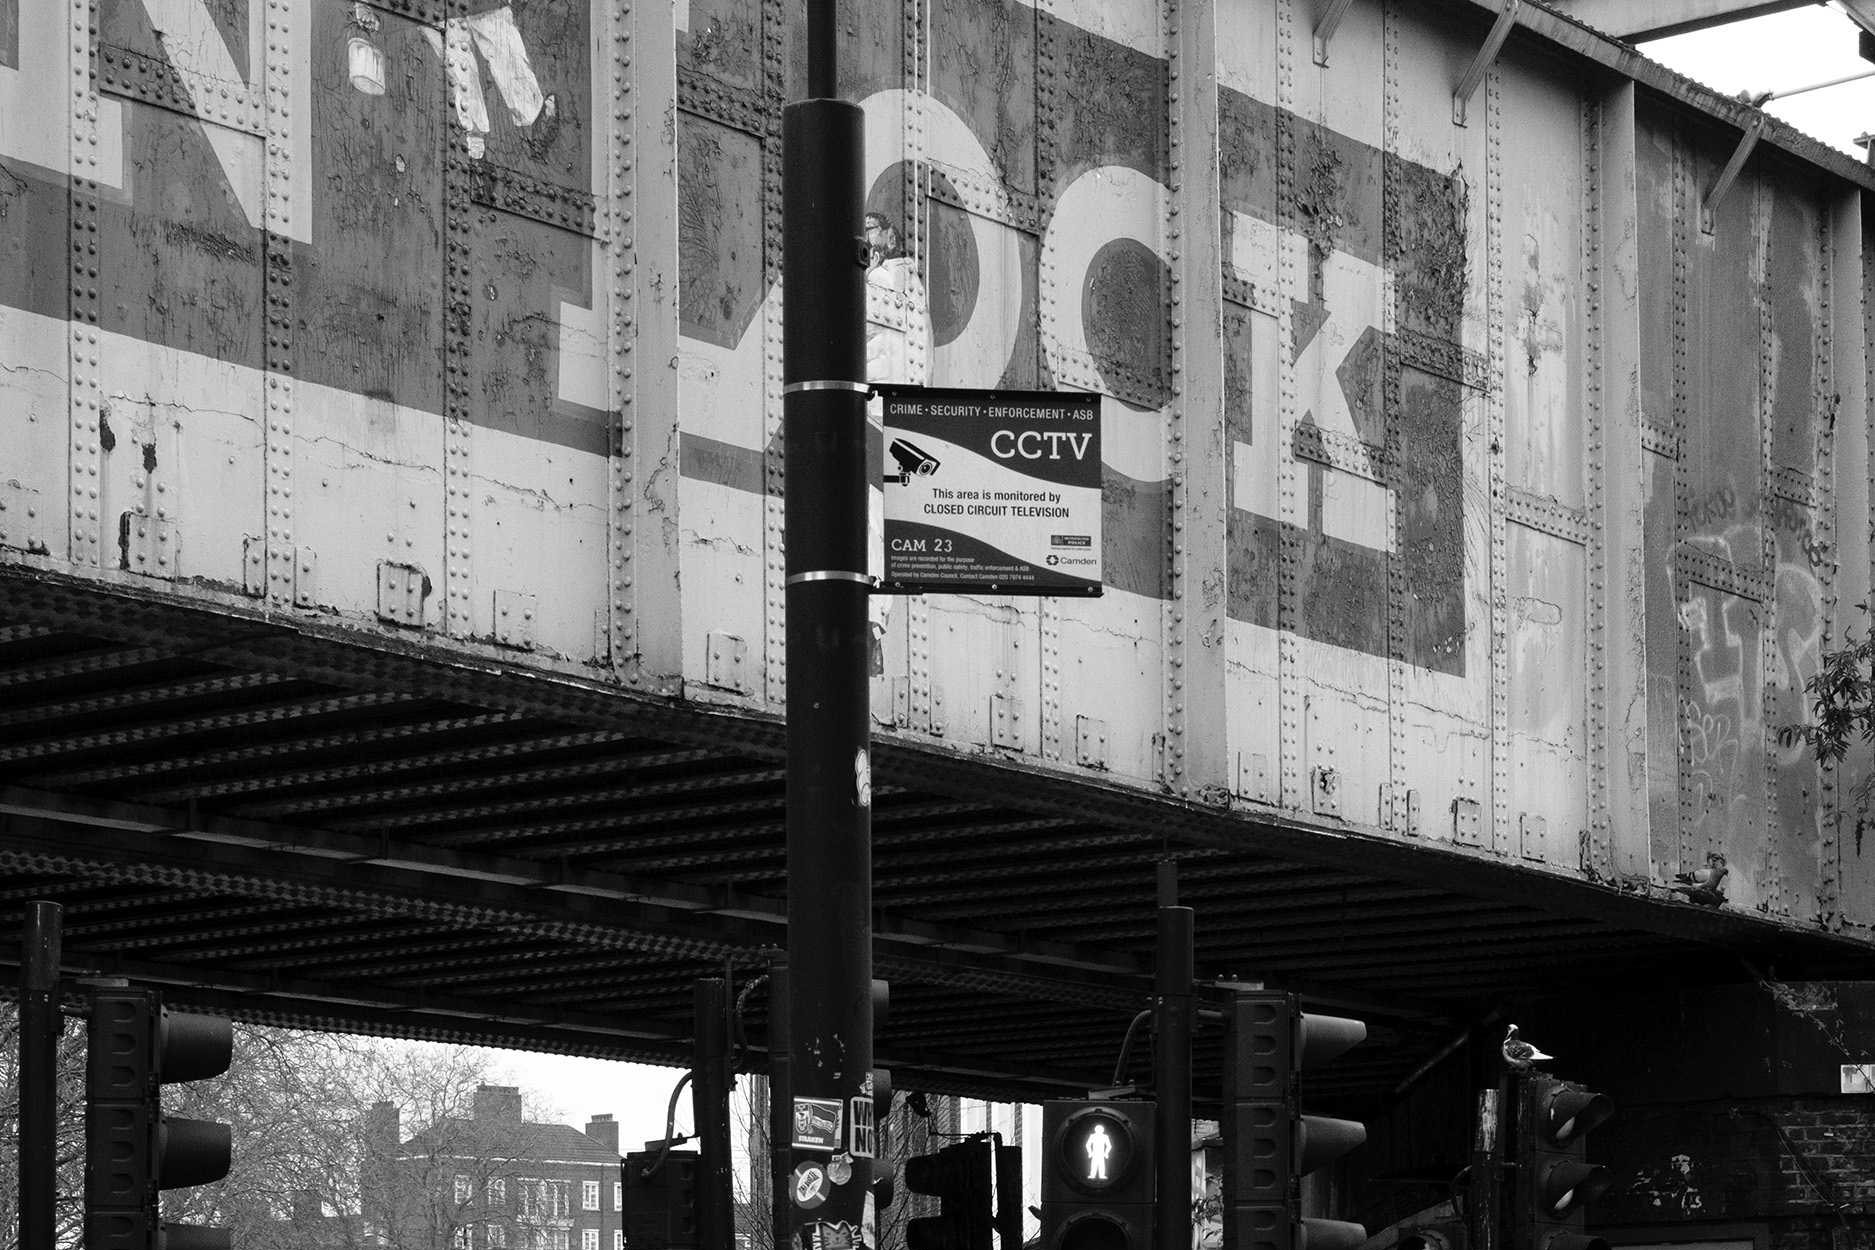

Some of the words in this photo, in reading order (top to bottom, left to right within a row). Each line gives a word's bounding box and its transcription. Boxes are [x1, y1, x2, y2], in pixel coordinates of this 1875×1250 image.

[890, 404, 923, 415] CRIME
[930, 405, 981, 417] SECURITY
[988, 407, 1065, 420] ENFORCEMENT
[1073, 409, 1093, 421] ASB
[990, 430, 1092, 460] CCTV
[932, 488, 954, 499] This
[956, 491, 979, 500] area
[982, 490, 991, 500] is
[994, 490, 1046, 502] monitored
[1049, 492, 1061, 504] by
[924, 504, 964, 515] CLOSED
[967, 504, 1008, 517] CIRCUIT
[1011, 506, 1070, 518] TELEVISION
[891, 538, 926, 552] CAM
[934, 539, 953, 552] 23
[1060, 556, 1097, 566] Camden
